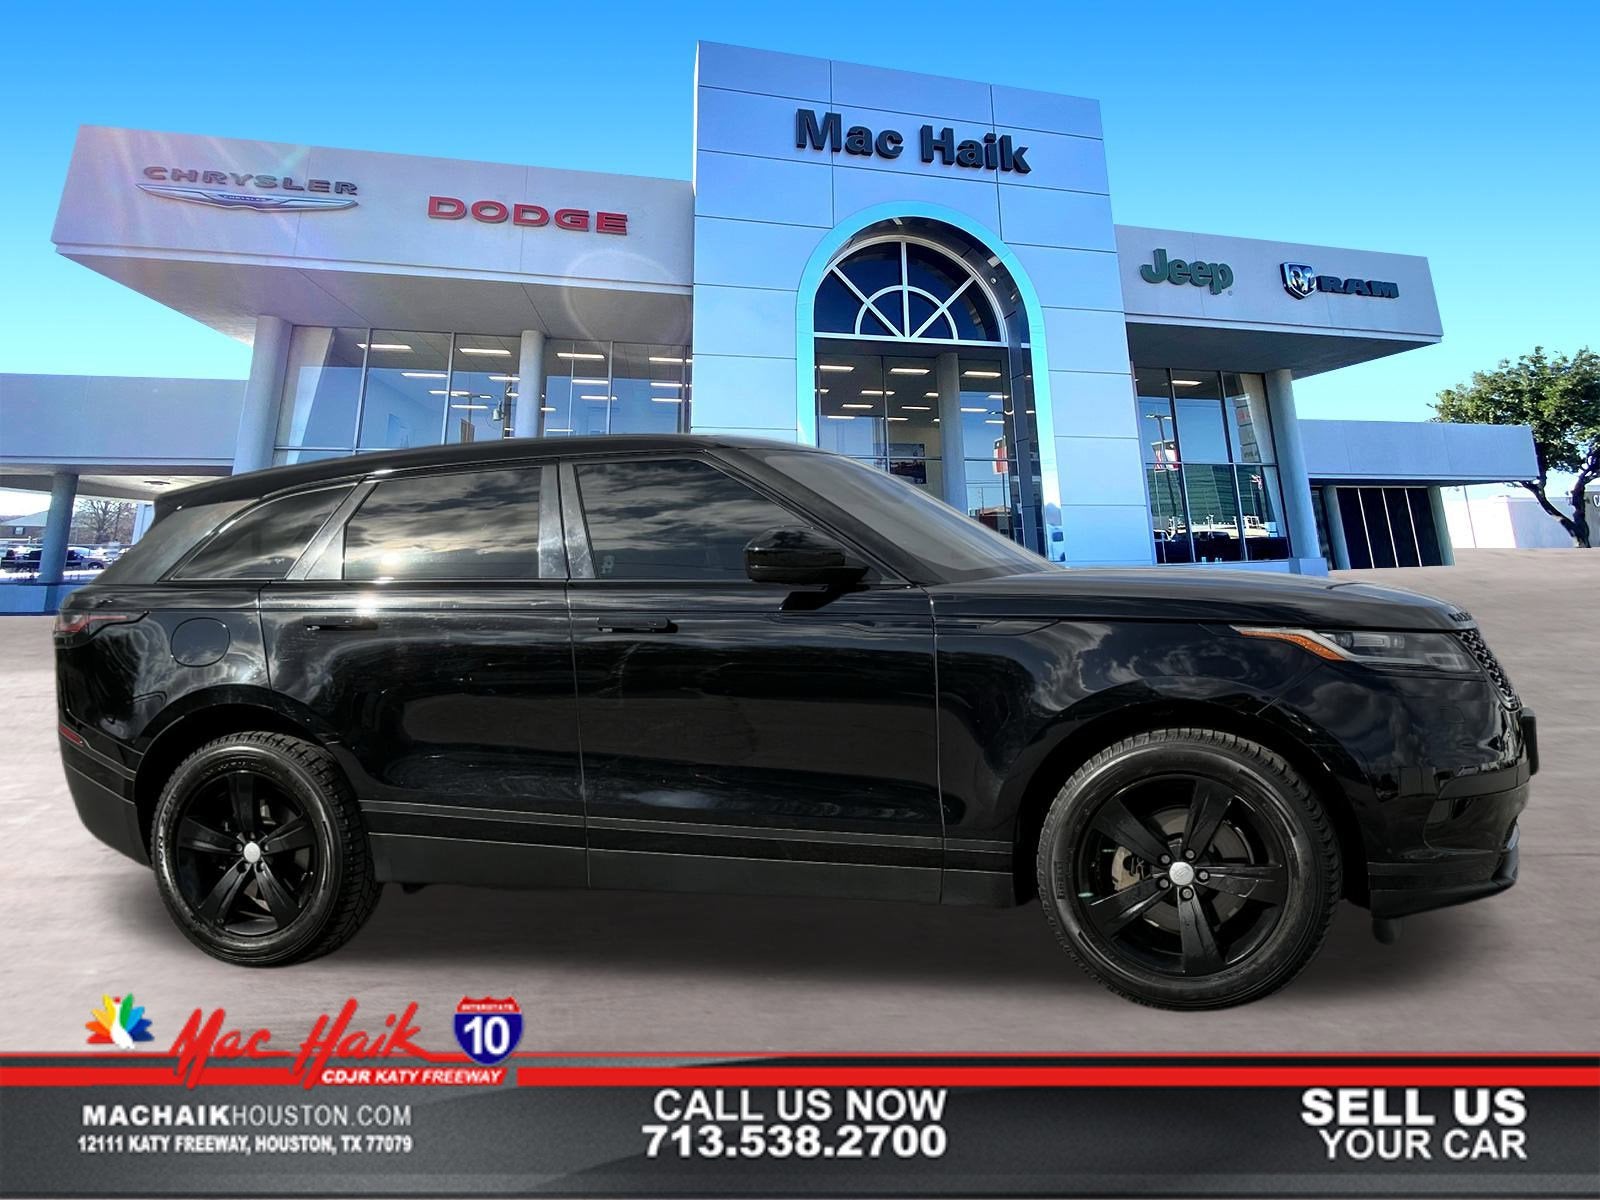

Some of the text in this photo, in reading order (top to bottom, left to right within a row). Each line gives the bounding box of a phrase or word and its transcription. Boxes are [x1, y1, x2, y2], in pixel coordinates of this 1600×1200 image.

[795, 108, 1032, 175] Mac Haik
[143, 166, 359, 196] CHRYSLER
[427, 195, 629, 236] DODGE
[1139, 248, 1234, 296] Jeep
[1315, 275, 1400, 299] RAM
